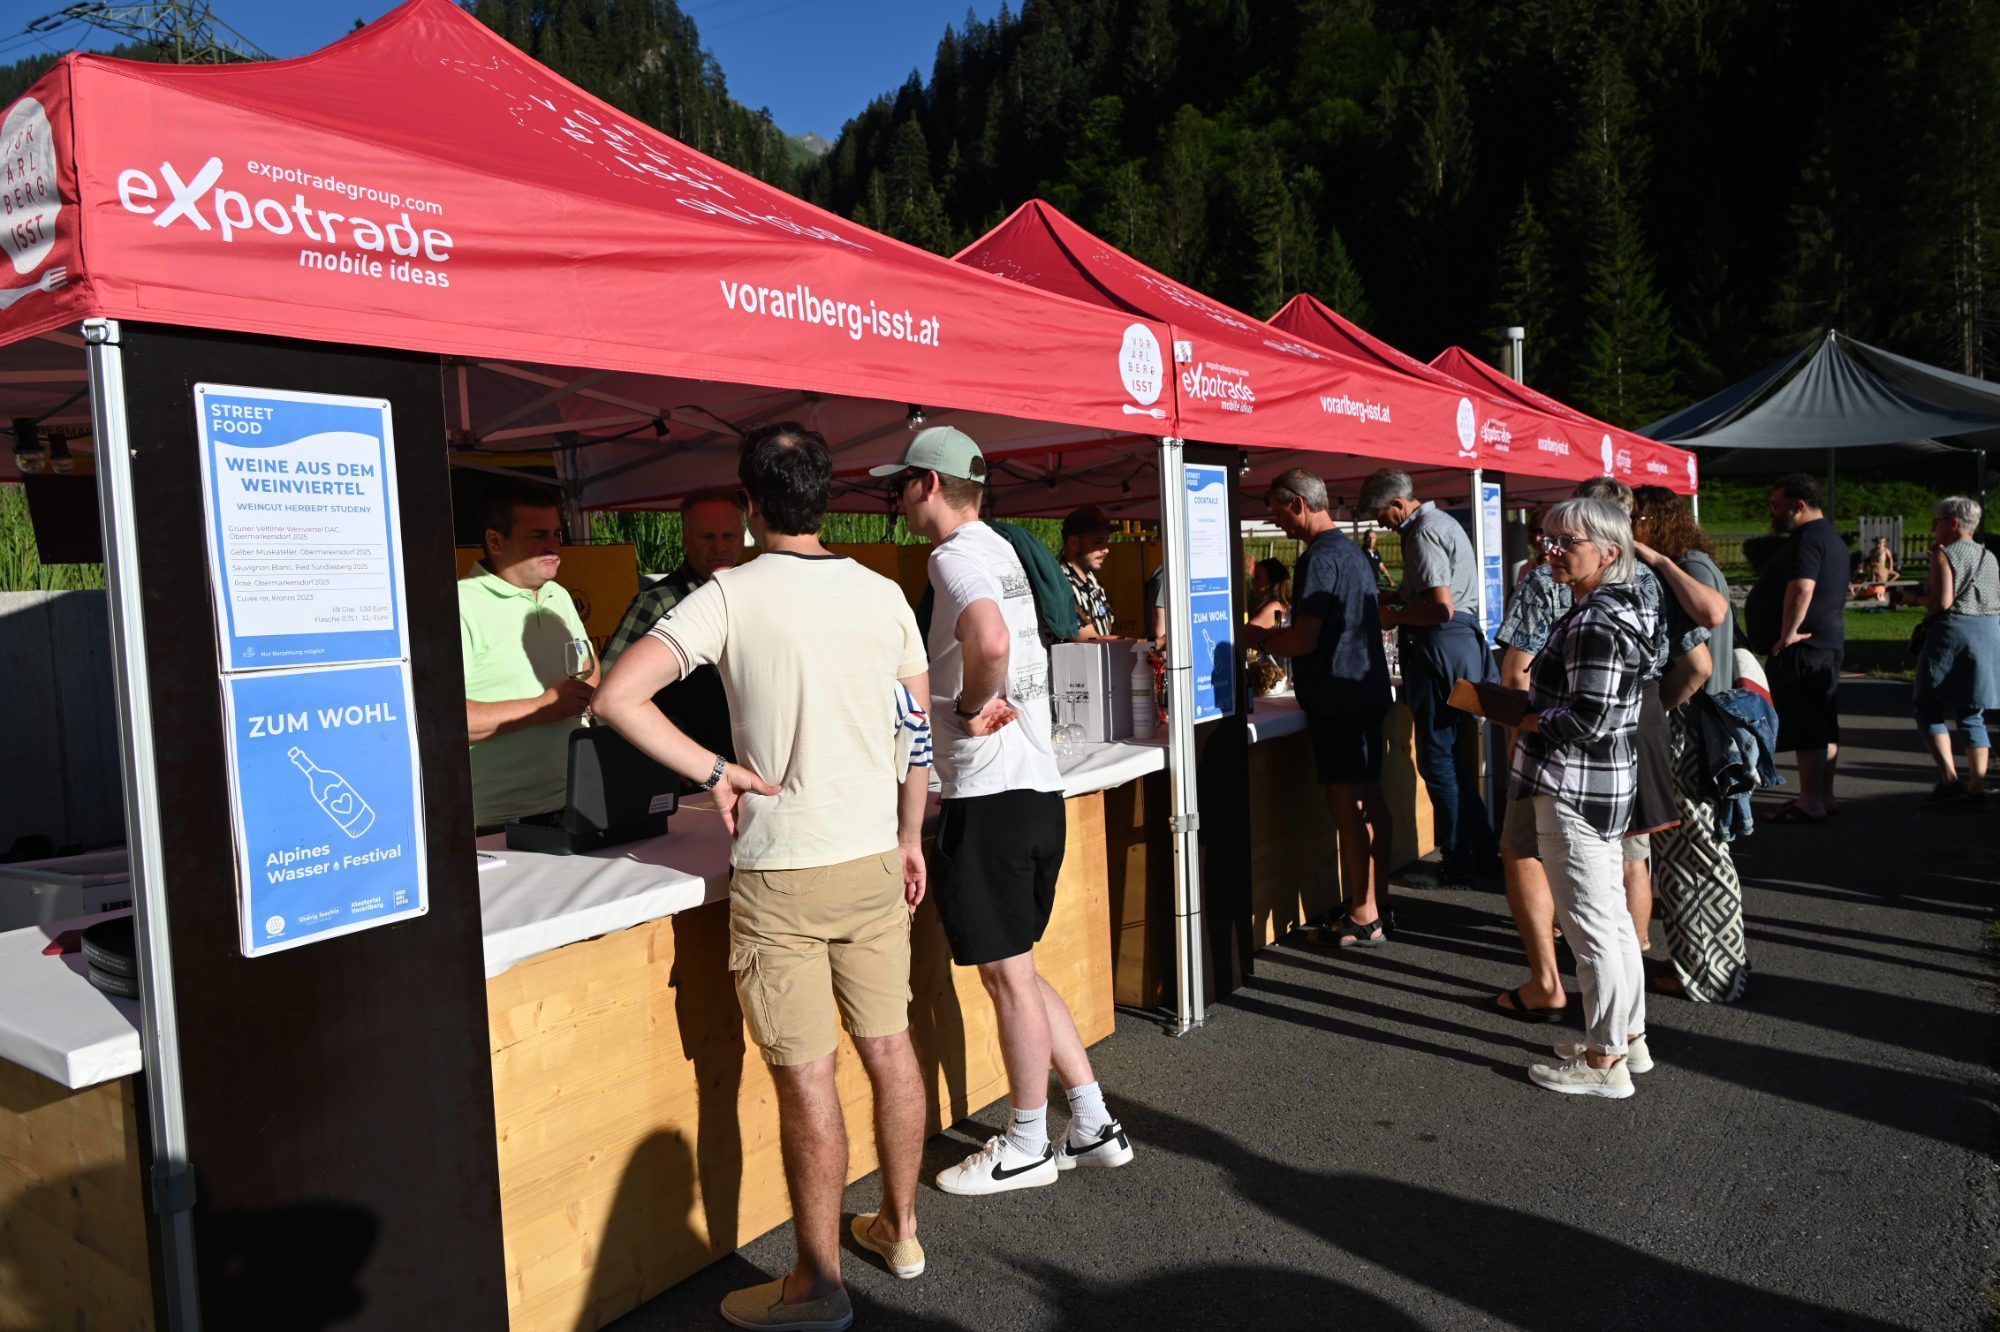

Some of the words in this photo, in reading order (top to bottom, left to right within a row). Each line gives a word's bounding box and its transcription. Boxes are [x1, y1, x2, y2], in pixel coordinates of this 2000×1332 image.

[4, 175, 46, 215] BERG
[246, 159, 444, 216] expotradegroup.com
[11, 214, 44, 252] ISST
[299, 249, 383, 279] mobile
[390, 258, 451, 288] ideas
[719, 279, 940, 347] vorarlberg-isst.at
[1132, 380, 1153, 393] ISST
[211, 403, 274, 420] STREET
[1320, 394, 1391, 423] vorarlberg-isst.at
[213, 419, 263, 435] FOOD
[225, 457, 289, 474] WEINE
[295, 460, 331, 476] AUS
[337, 462, 375, 478] DEM
[241, 477, 366, 497] WEINVIERTEL
[236, 502, 284, 512] WEINGUT
[285, 503, 329, 513] HERBERT
[330, 504, 372, 513] STUDENY
[232, 564, 271, 572] Sauvignon
[1193, 612, 1208, 624] ZUM
[1208, 610, 1228, 622] WOHL
[248, 711, 309, 738] ZUM
[317, 702, 397, 729] WOHL
[265, 844, 331, 868] Alpines
[267, 860, 330, 884] Wasser
[343, 844, 402, 869] Festival
